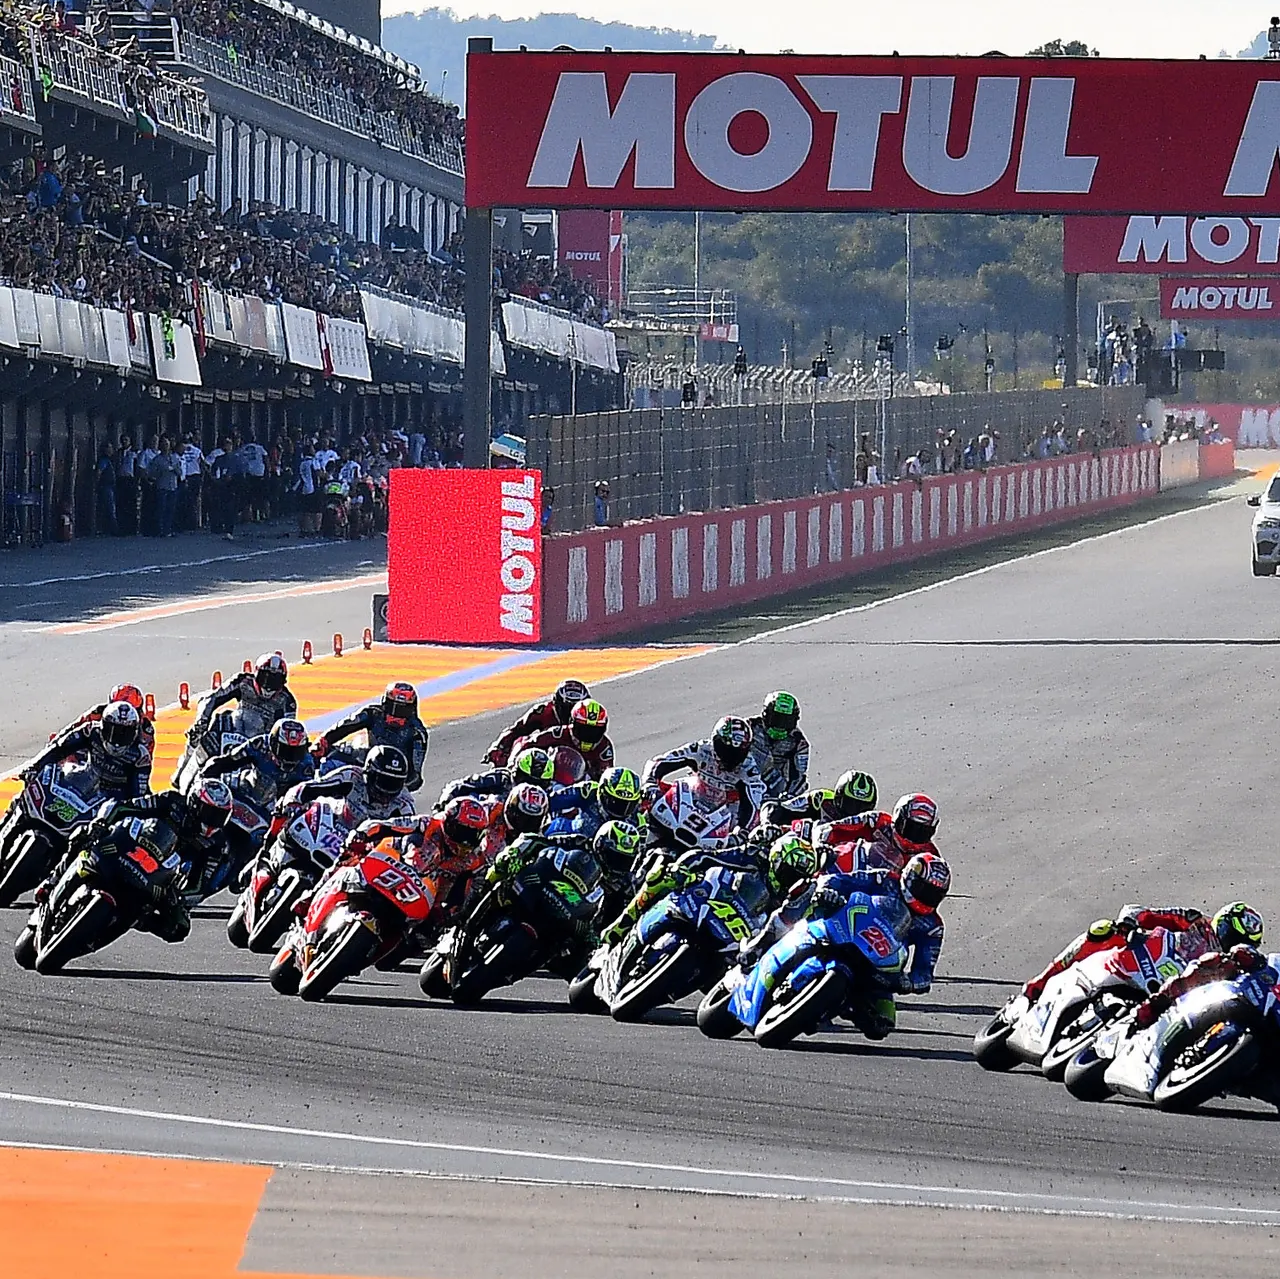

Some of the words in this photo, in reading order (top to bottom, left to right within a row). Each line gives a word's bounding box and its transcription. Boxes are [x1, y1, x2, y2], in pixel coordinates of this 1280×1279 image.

[527, 72, 1099, 196] MOTUL
[565, 251, 601, 262] MOTUL
[1172, 287, 1274, 311] MOTUL
[500, 475, 536, 636] MOTUL
[373, 869, 420, 903] 93
[385, 857, 426, 891] REPSOL
[549, 880, 581, 905] 44
[707, 899, 752, 941] 46
[858, 926, 891, 959] 25
[1140, 958, 1154, 977] TIM
